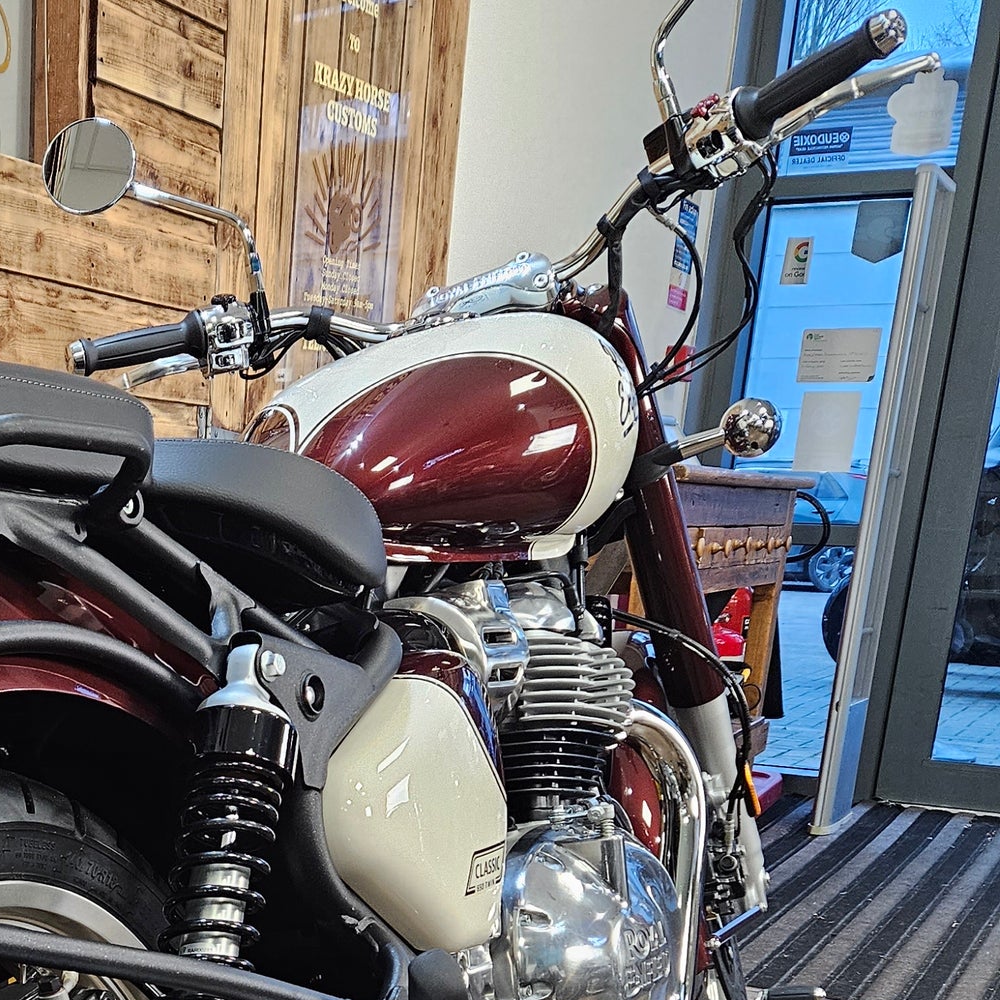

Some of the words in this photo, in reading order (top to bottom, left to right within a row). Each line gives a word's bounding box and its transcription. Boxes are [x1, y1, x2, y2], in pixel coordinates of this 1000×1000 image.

[349, 33, 360, 53] TO
[314, 61, 355, 97] KRAZY
[354, 78, 391, 112] HORSE
[327, 100, 378, 138] CUSTOMS
[475, 856, 500, 879] CLASSIC
